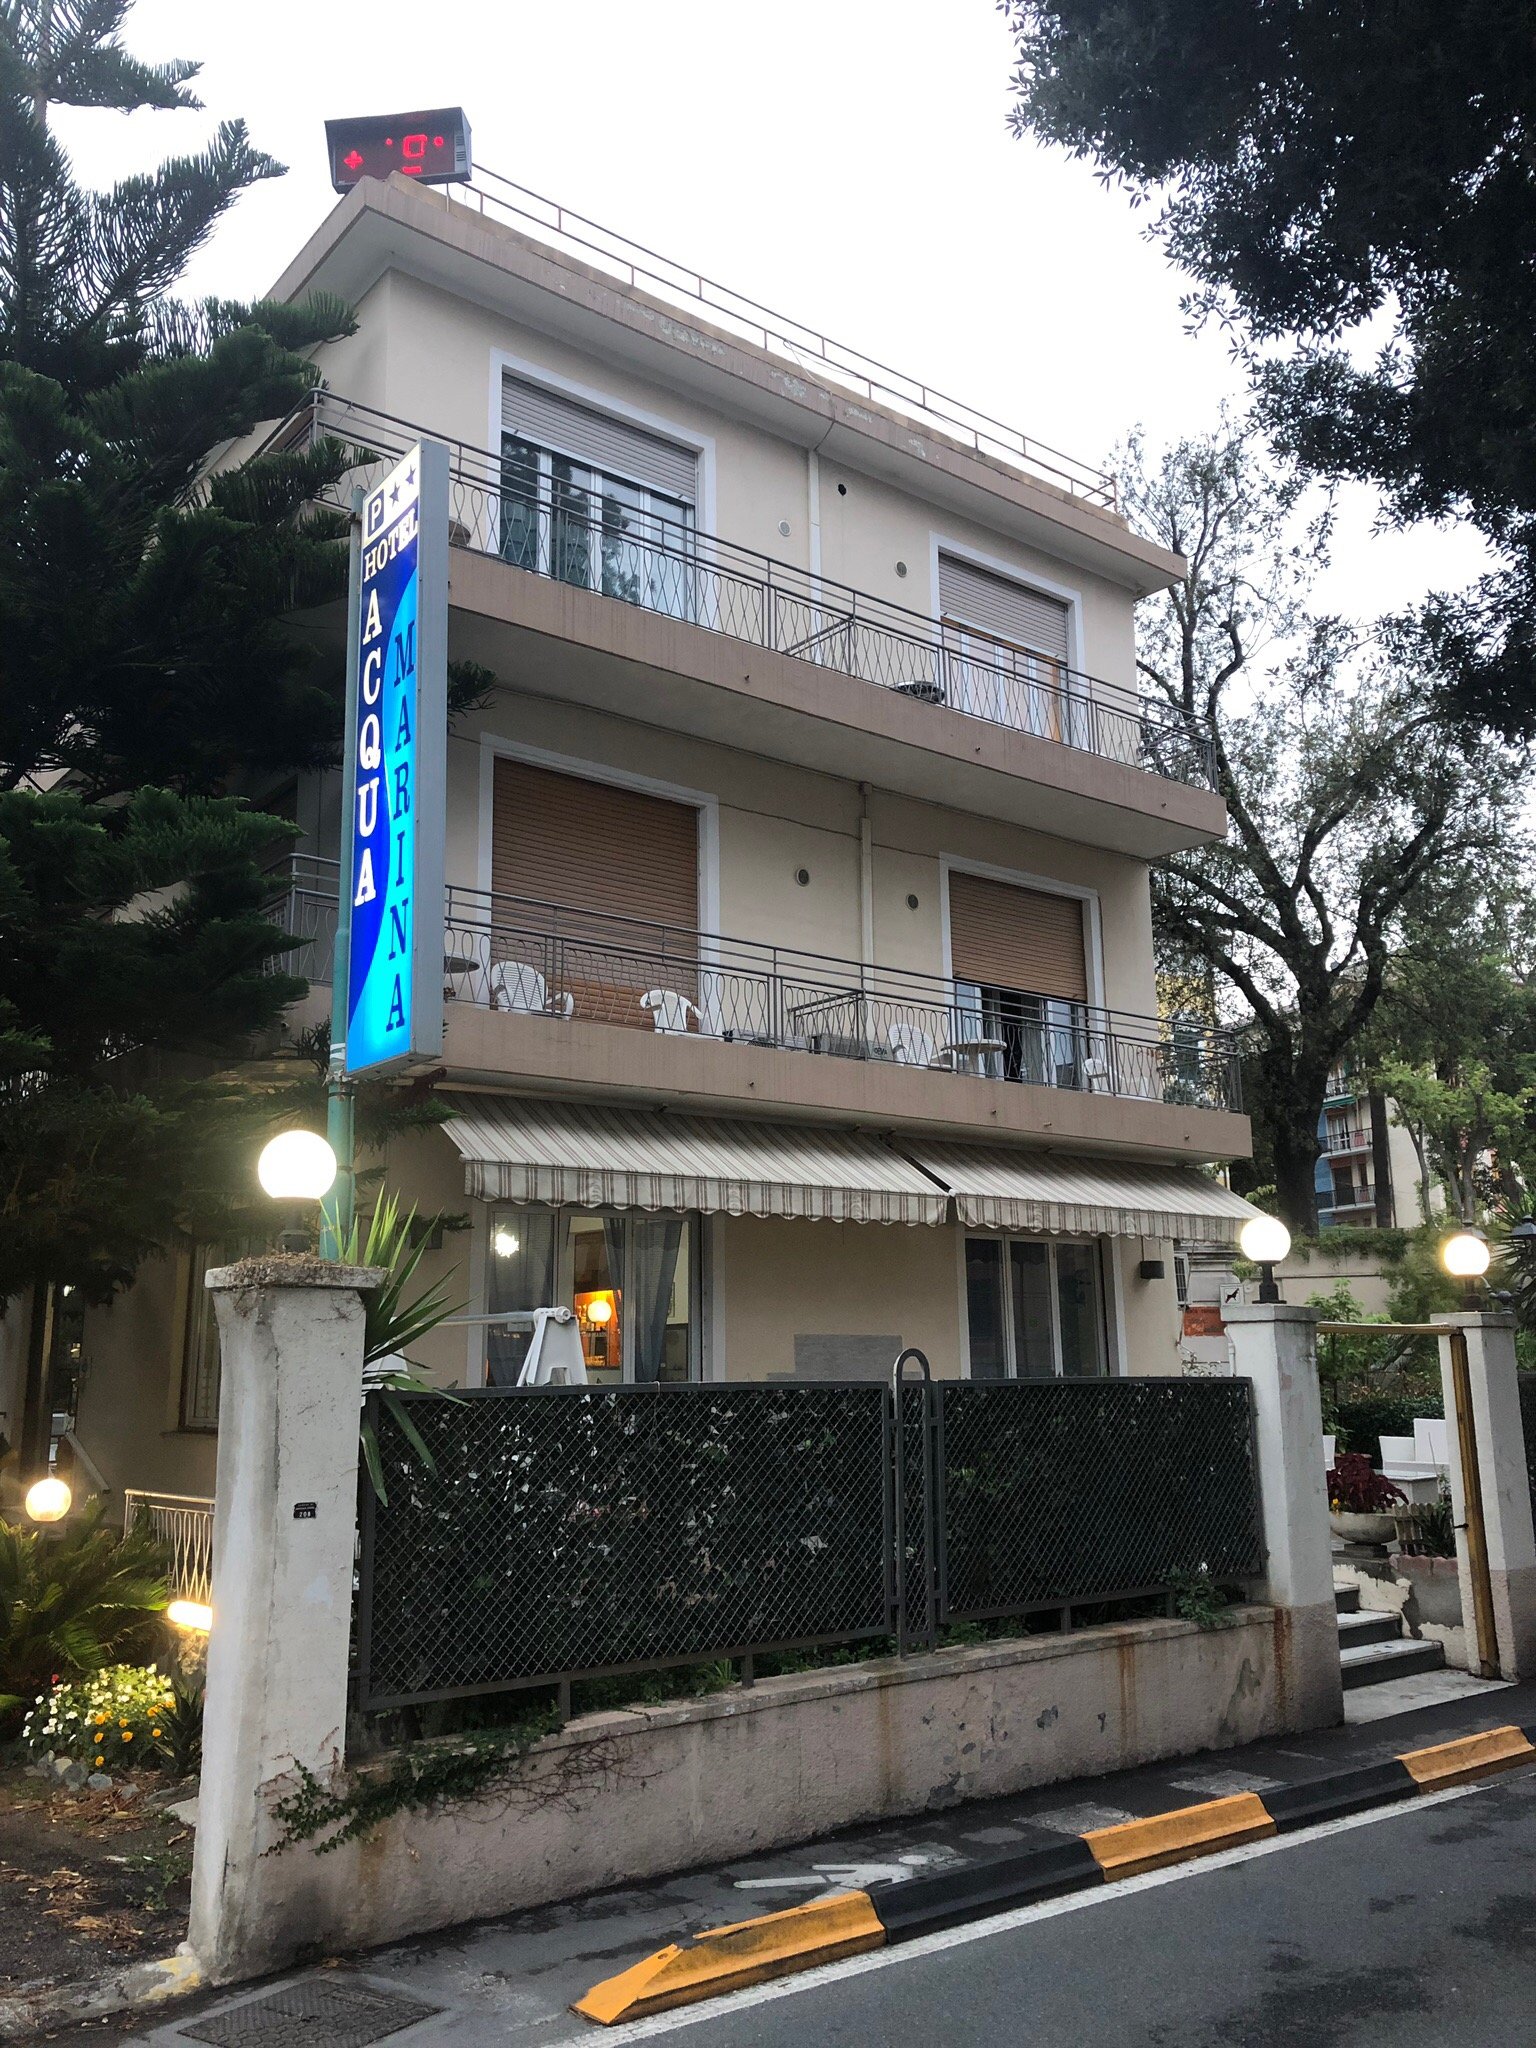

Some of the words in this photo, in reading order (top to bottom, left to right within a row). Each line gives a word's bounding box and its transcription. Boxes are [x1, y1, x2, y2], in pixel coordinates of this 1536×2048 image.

[363, 508, 418, 583] HOTEL
[354, 588, 383, 907] ACQUA
[386, 619, 415, 1033] MARINA
